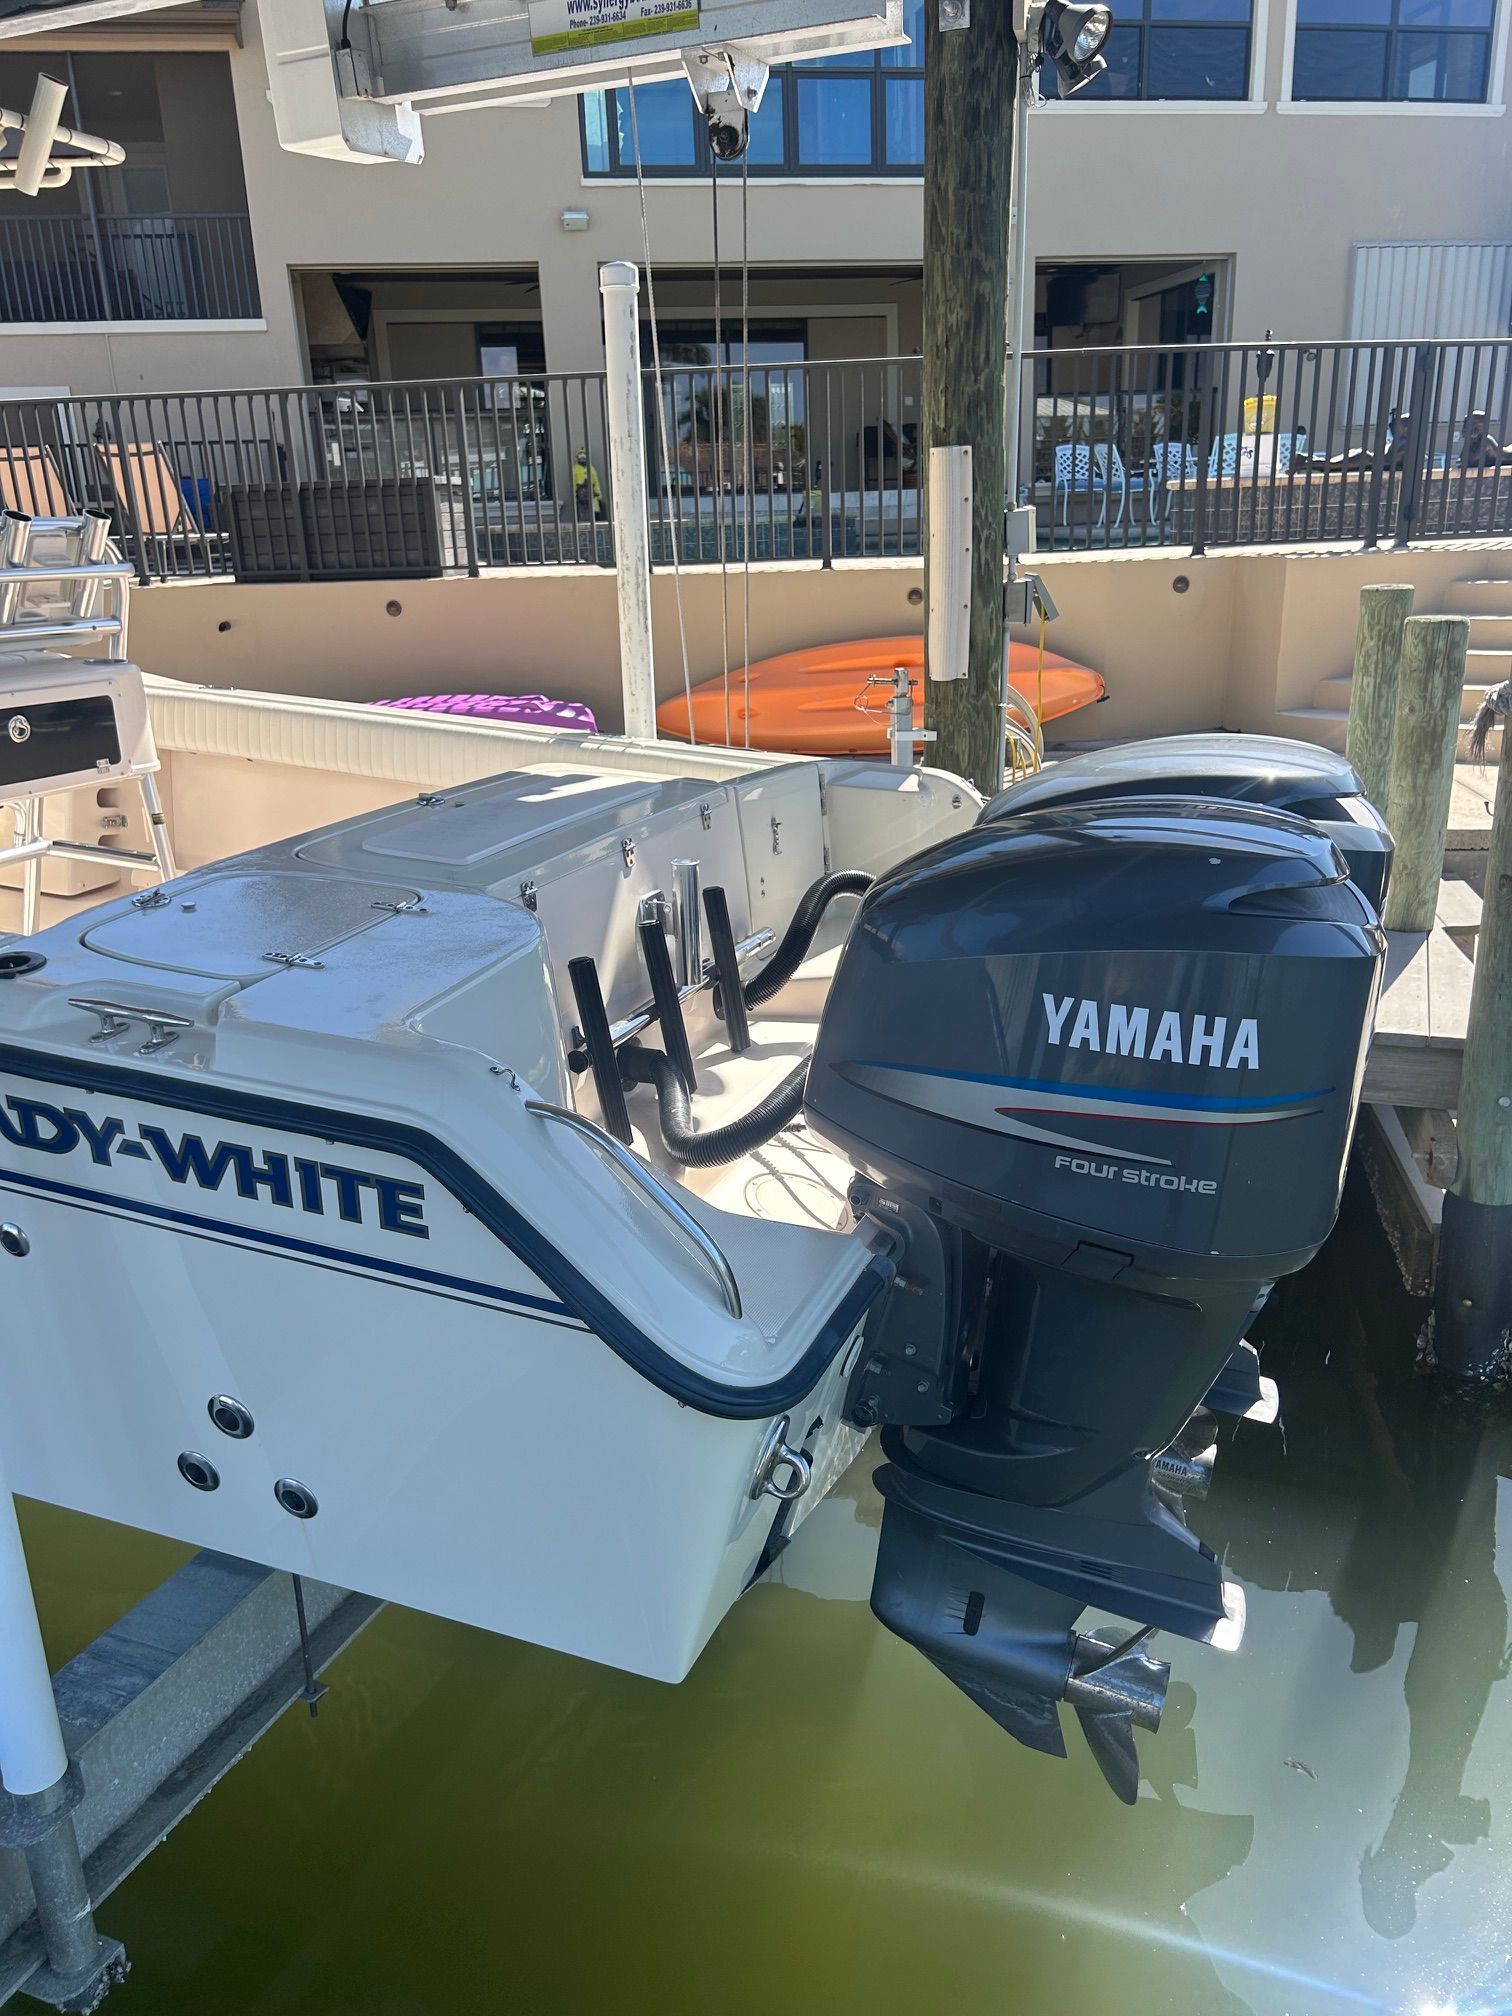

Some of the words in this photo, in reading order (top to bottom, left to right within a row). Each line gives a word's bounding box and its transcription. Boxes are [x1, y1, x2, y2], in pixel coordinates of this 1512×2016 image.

[589, 11, 627, 25] 239-931-6634
[1042, 993, 1259, 1070] YAMAHA
[1154, 1459, 1187, 1476] AMAHA
